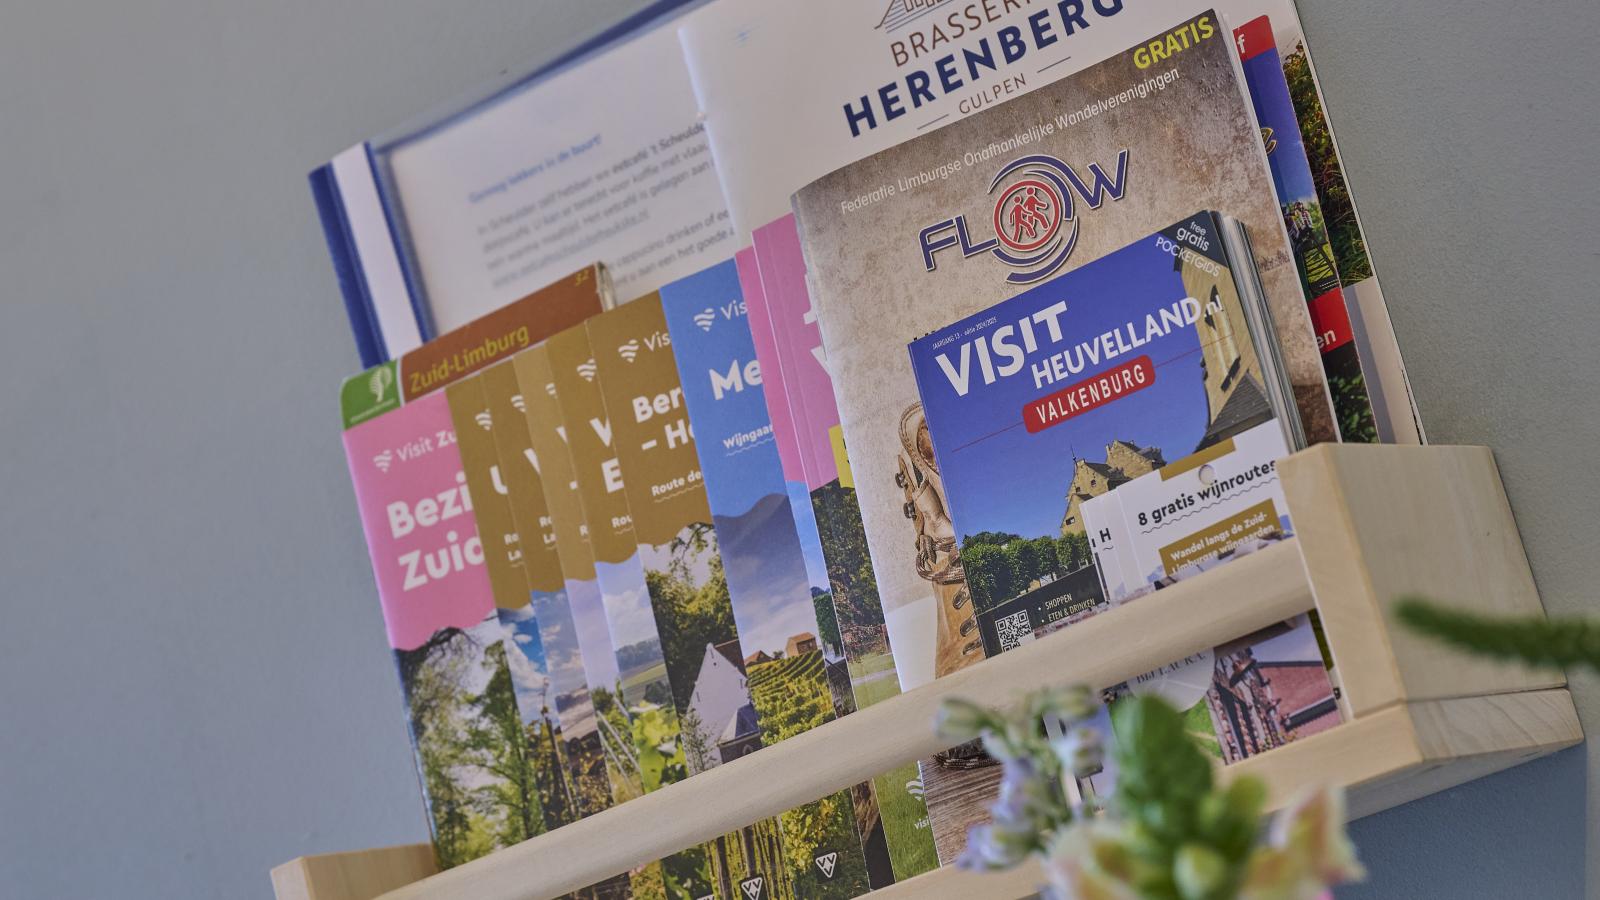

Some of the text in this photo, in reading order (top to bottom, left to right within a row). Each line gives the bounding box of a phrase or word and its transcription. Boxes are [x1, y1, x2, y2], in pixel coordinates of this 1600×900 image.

[1133, 16, 1215, 70] GRATIS
[958, 73, 1027, 115] GULPEN
[840, 67, 1180, 215] Federatie Limburgse Onafhankelijke Wandelverenigingen
[1155, 236, 1221, 277] POCKETGIDS
[1176, 221, 1210, 252] free gratis
[408, 325, 530, 394] Zuid-Limburg
[935, 301, 1068, 397] VISIT
[709, 359, 762, 401] Me
[1036, 364, 1146, 424] VALKENBURG
[397, 438, 434, 462] Visit
[651, 476, 686, 498] Route
[1137, 512, 1148, 527] 8
[1151, 492, 1195, 524] gratis
[1170, 511, 1268, 561] Wandel langs de Zuid-
[1045, 592, 1072, 610] SHOPPEN
[1048, 609, 1064, 622] ETEN
[1069, 597, 1096, 615] DRINKEN
